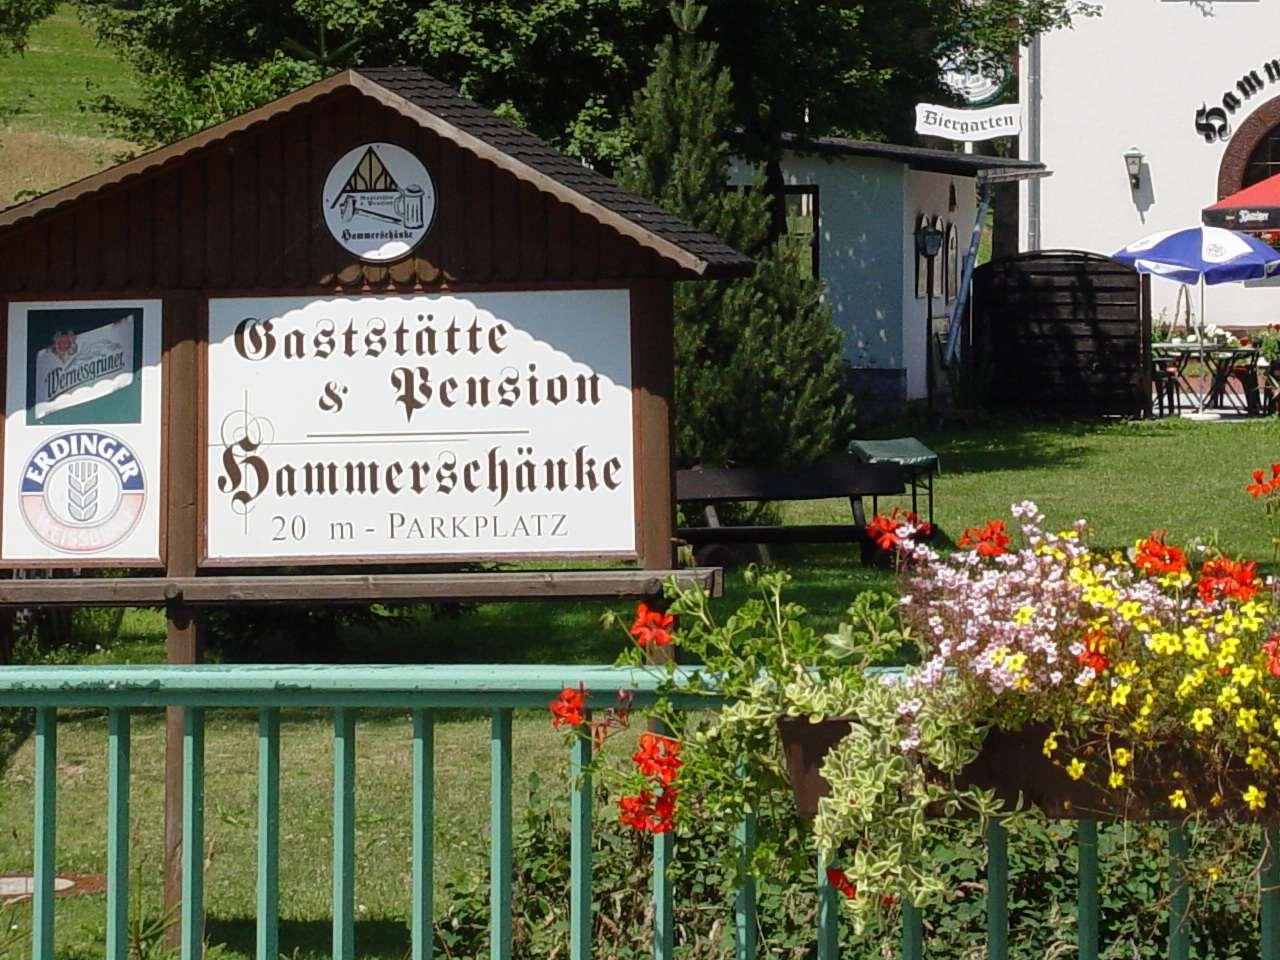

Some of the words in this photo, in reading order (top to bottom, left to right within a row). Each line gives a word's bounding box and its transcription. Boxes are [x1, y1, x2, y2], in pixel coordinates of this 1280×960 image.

[923, 110, 1014, 134] Biergarten
[234, 314, 508, 361] Gaststätte
[318, 380, 349, 414] &
[391, 363, 601, 424] Pension
[26, 434, 139, 485] ERDINGER
[218, 436, 622, 508] Hammerschänke
[272, 515, 306, 541] 20
[330, 521, 353, 540] m
[389, 513, 569, 540] PARKPLATZ
